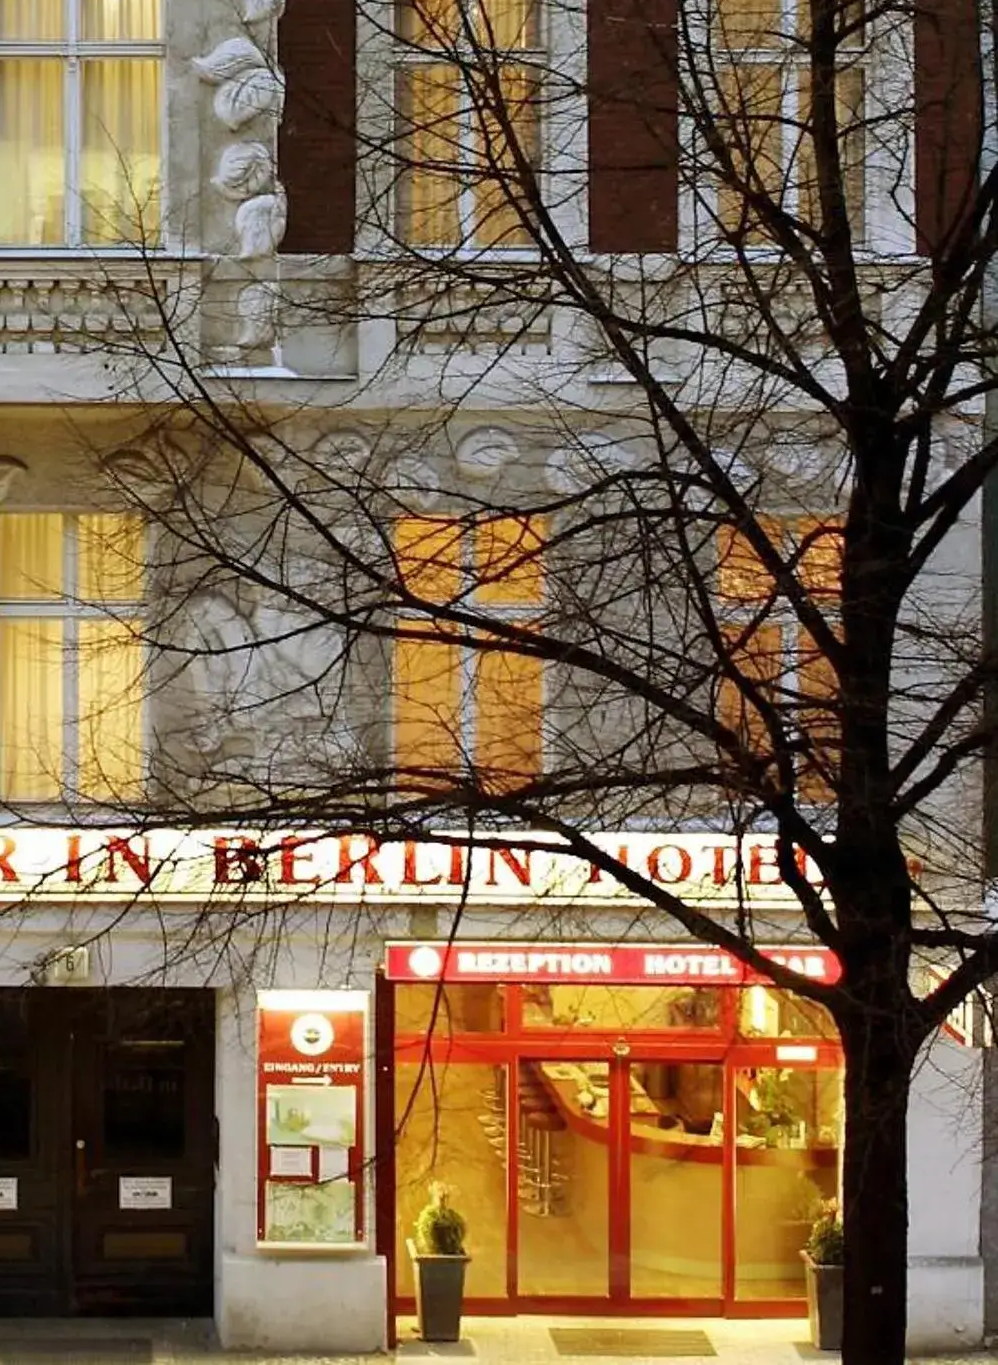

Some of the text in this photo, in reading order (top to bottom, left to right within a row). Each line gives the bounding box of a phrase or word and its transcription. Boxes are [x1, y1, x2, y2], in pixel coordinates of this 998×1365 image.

[65, 834, 151, 886] IN
[212, 832, 532, 886] BERLIN
[457, 952, 826, 978] REZEPTION HOTEL AR
